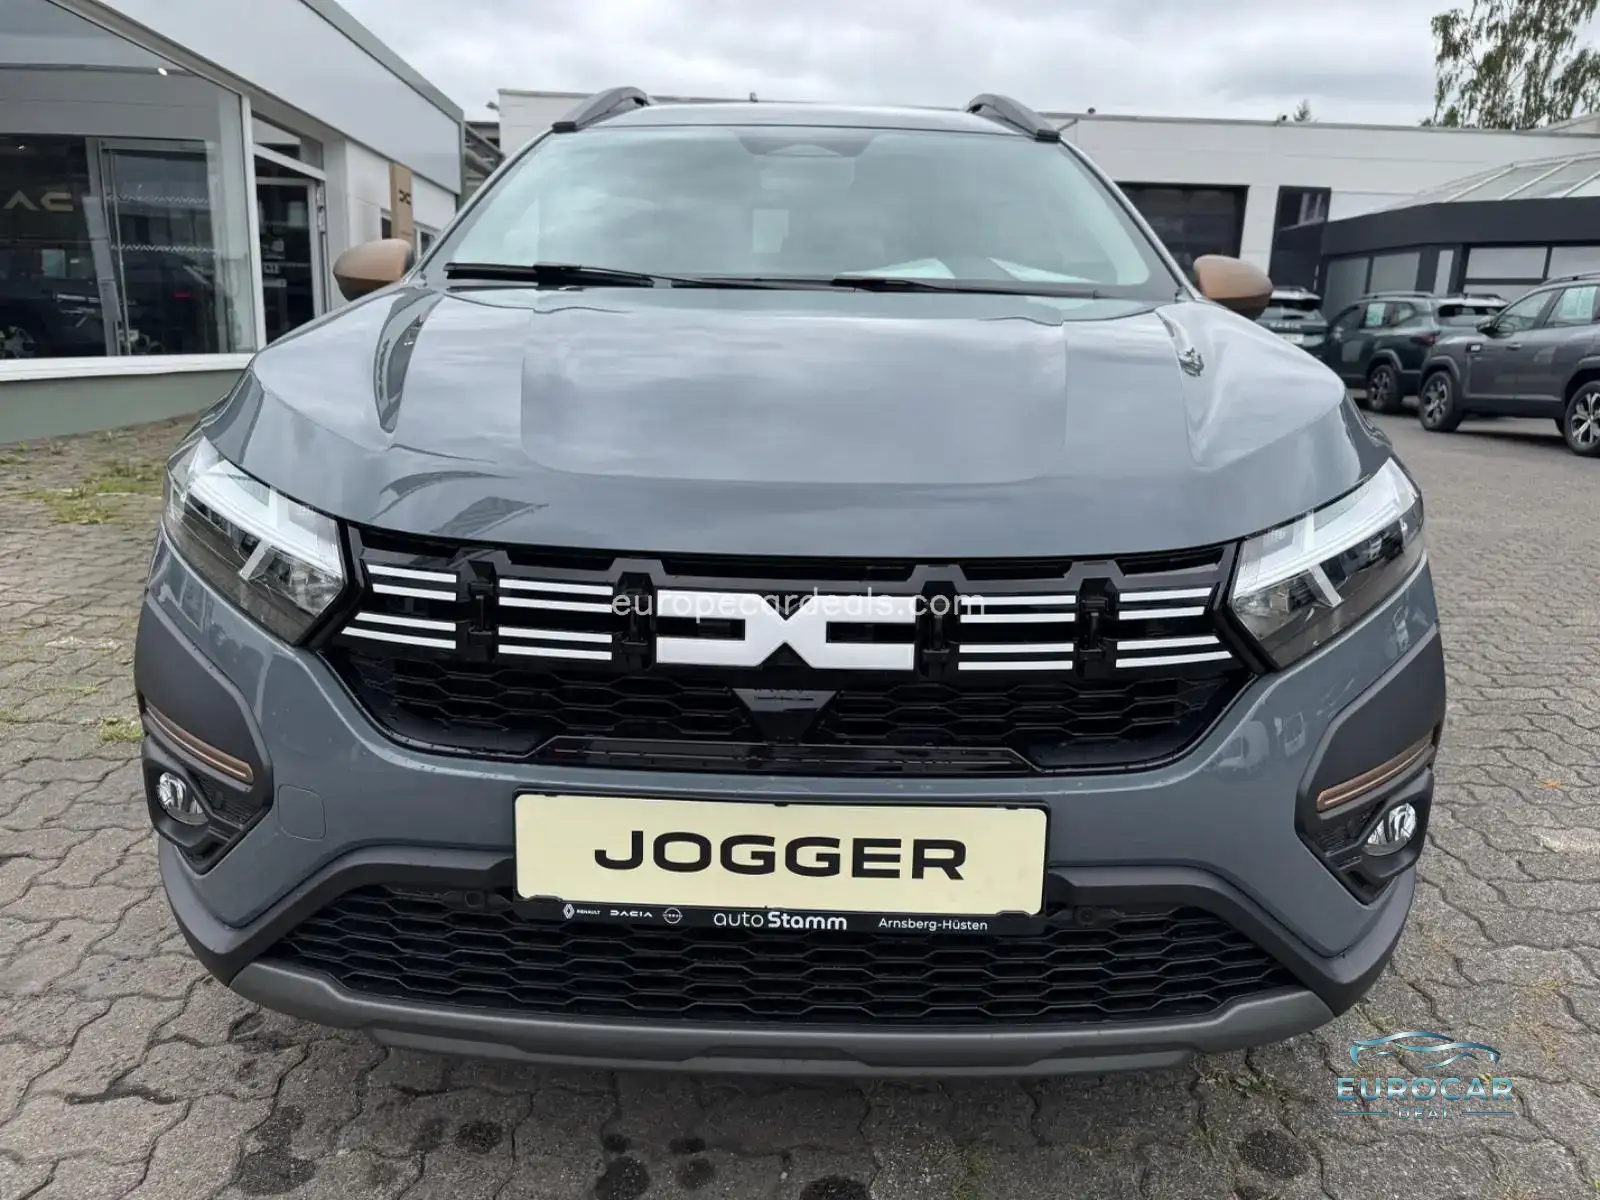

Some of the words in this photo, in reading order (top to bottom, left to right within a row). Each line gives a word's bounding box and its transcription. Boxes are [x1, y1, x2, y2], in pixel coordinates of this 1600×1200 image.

[594, 830, 967, 881] JOGGER
[610, 909, 653, 918] DACIA
[713, 911, 764, 928] auto
[767, 911, 848, 931] Stamm
[878, 916, 988, 932] Arnsberg-Hüsten
